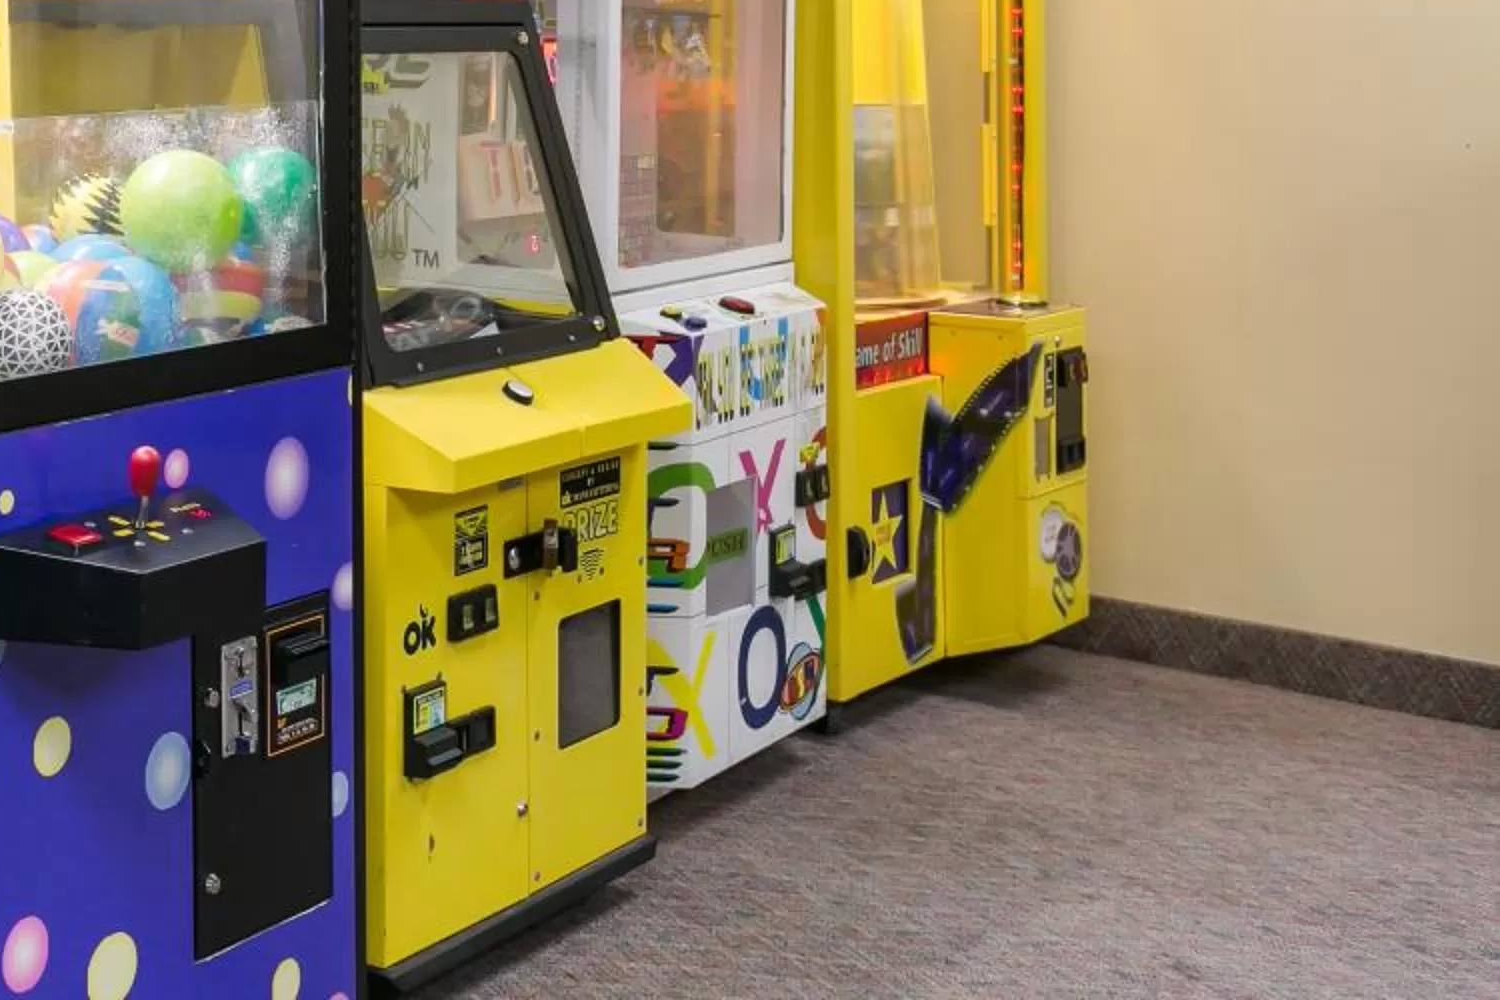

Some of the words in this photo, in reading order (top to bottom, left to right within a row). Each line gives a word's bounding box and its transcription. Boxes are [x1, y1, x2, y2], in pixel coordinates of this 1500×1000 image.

[412, 248, 441, 270] TM
[855, 343, 880, 368] ame
[883, 331, 897, 362] of
[897, 327, 924, 360] Skill
[403, 606, 437, 656] OK
